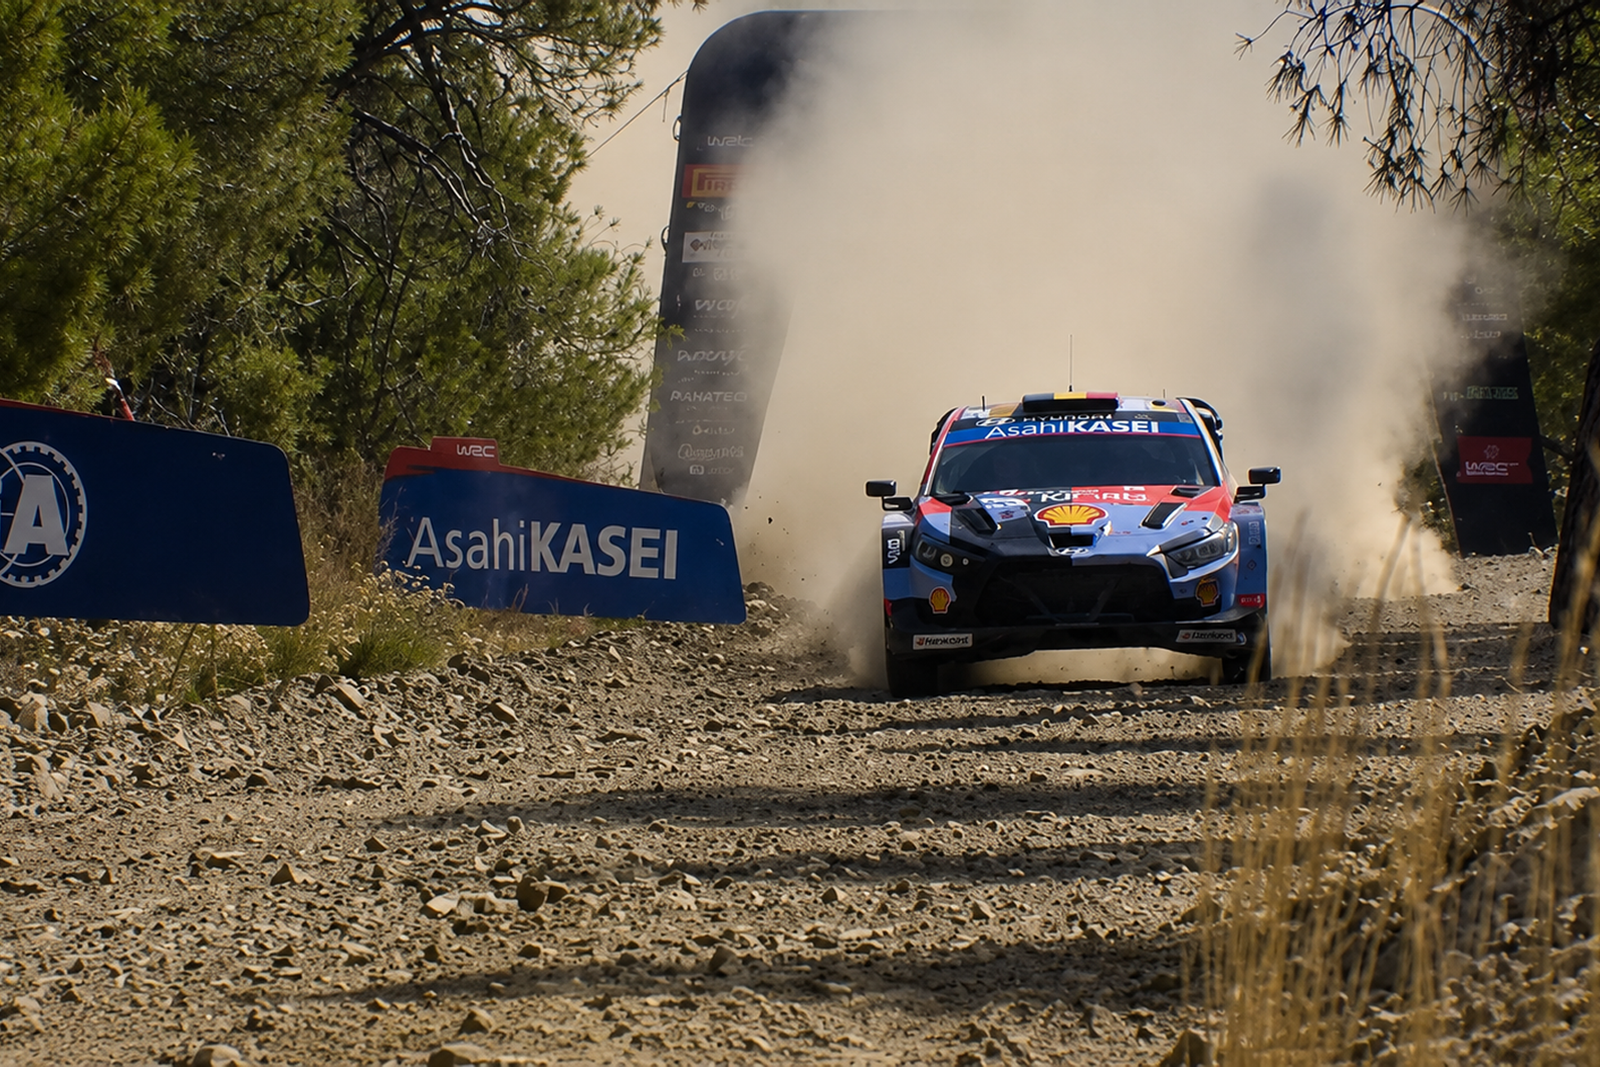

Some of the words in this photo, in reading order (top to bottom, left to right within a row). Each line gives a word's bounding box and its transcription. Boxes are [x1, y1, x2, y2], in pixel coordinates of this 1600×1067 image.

[984, 420, 1159, 440] AsahiKASEI
[456, 444, 495, 458] WRC
[407, 516, 679, 580] AsahiKASEI
